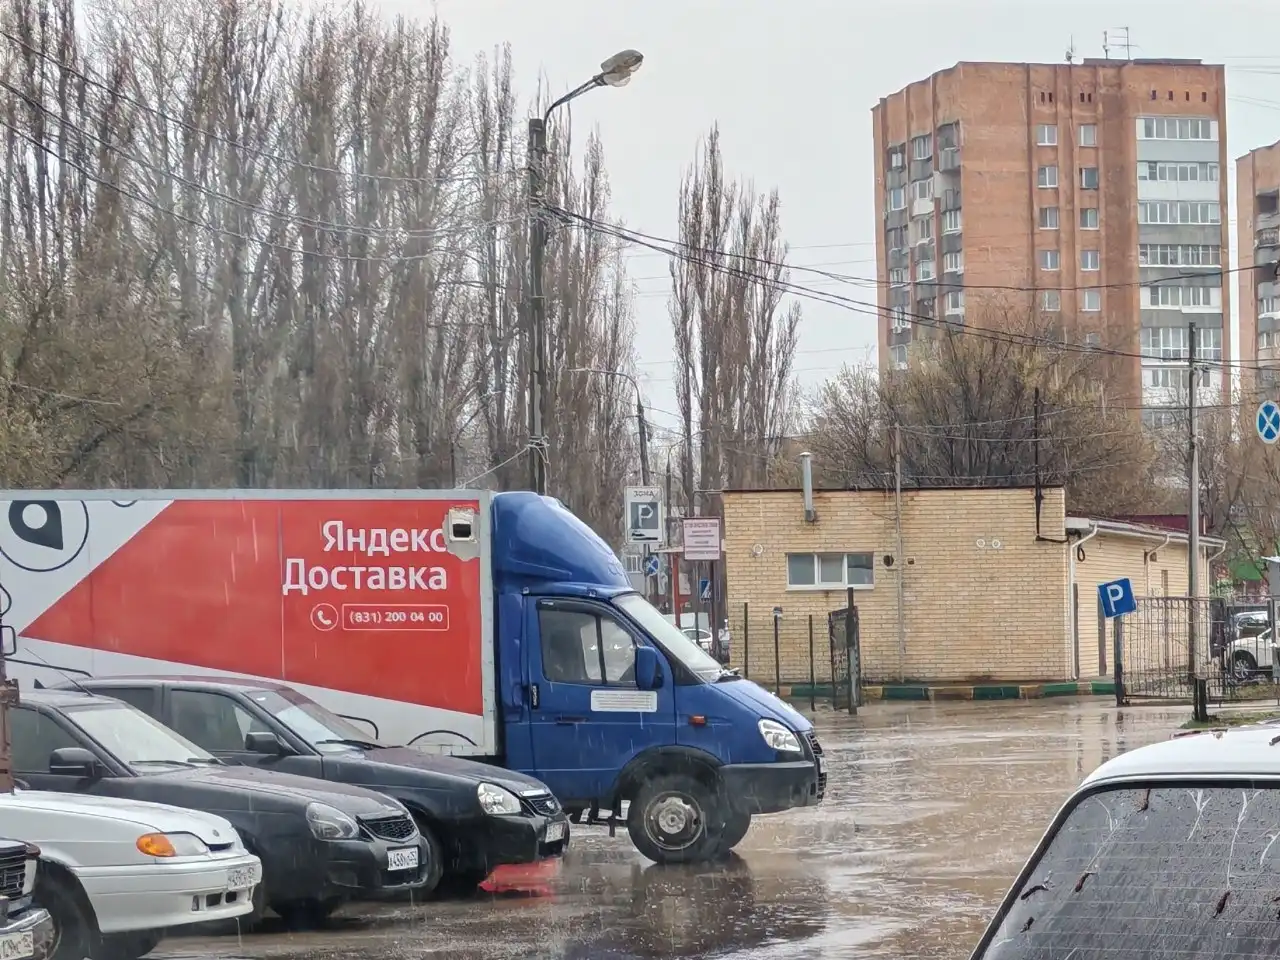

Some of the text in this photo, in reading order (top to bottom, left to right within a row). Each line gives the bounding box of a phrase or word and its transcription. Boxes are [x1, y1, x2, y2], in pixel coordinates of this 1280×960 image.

[638, 504, 654, 528] P
[322, 520, 448, 556] Яндекс
[282, 558, 447, 595] Доставка
[1106, 584, 1124, 612] P
[350, 611, 443, 624] (831) 200 04 00
